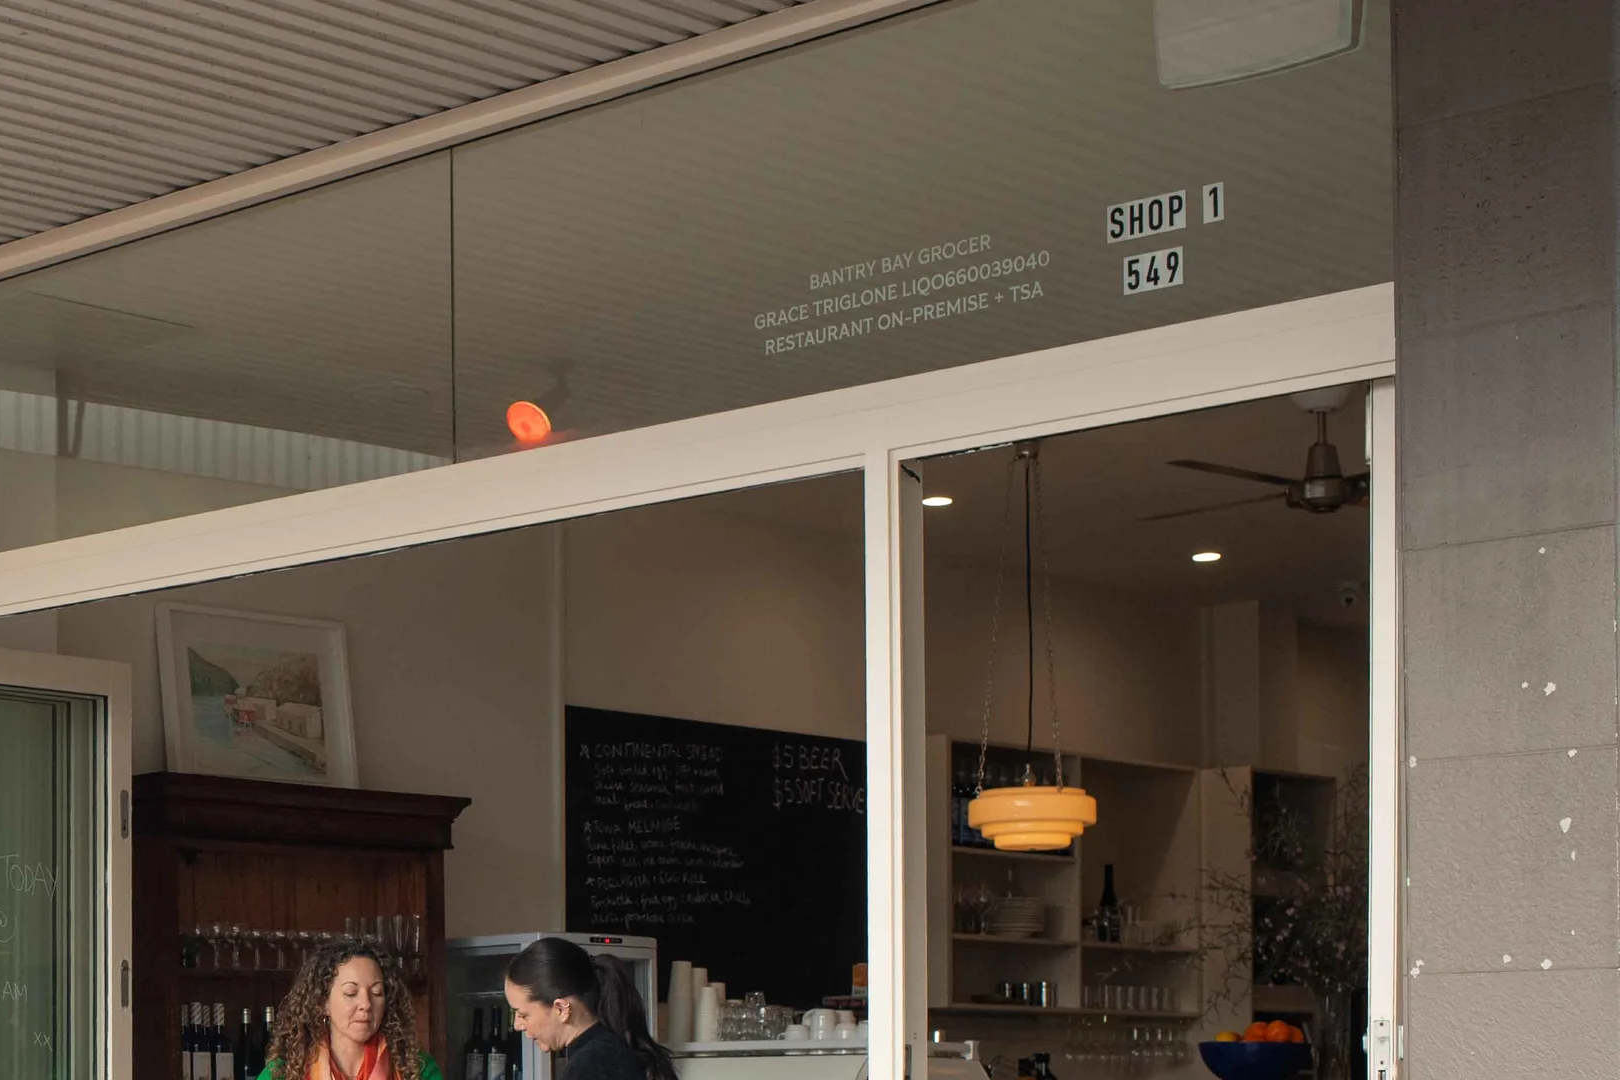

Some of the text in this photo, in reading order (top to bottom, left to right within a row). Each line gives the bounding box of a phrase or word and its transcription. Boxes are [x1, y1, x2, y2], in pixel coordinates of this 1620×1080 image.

[1109, 185, 1220, 239] SHOP 1
[810, 234, 992, 290] BANTRY BAY GROCER
[1127, 251, 1181, 291] 549
[754, 304, 809, 330] GRACE
[812, 284, 897, 317] TRIGLONE
[765, 317, 875, 355] RESTAURANT
[877, 292, 989, 331] ON-PREMISE
[1009, 281, 1045, 303] TSA
[798, 744, 850, 782] BEER
